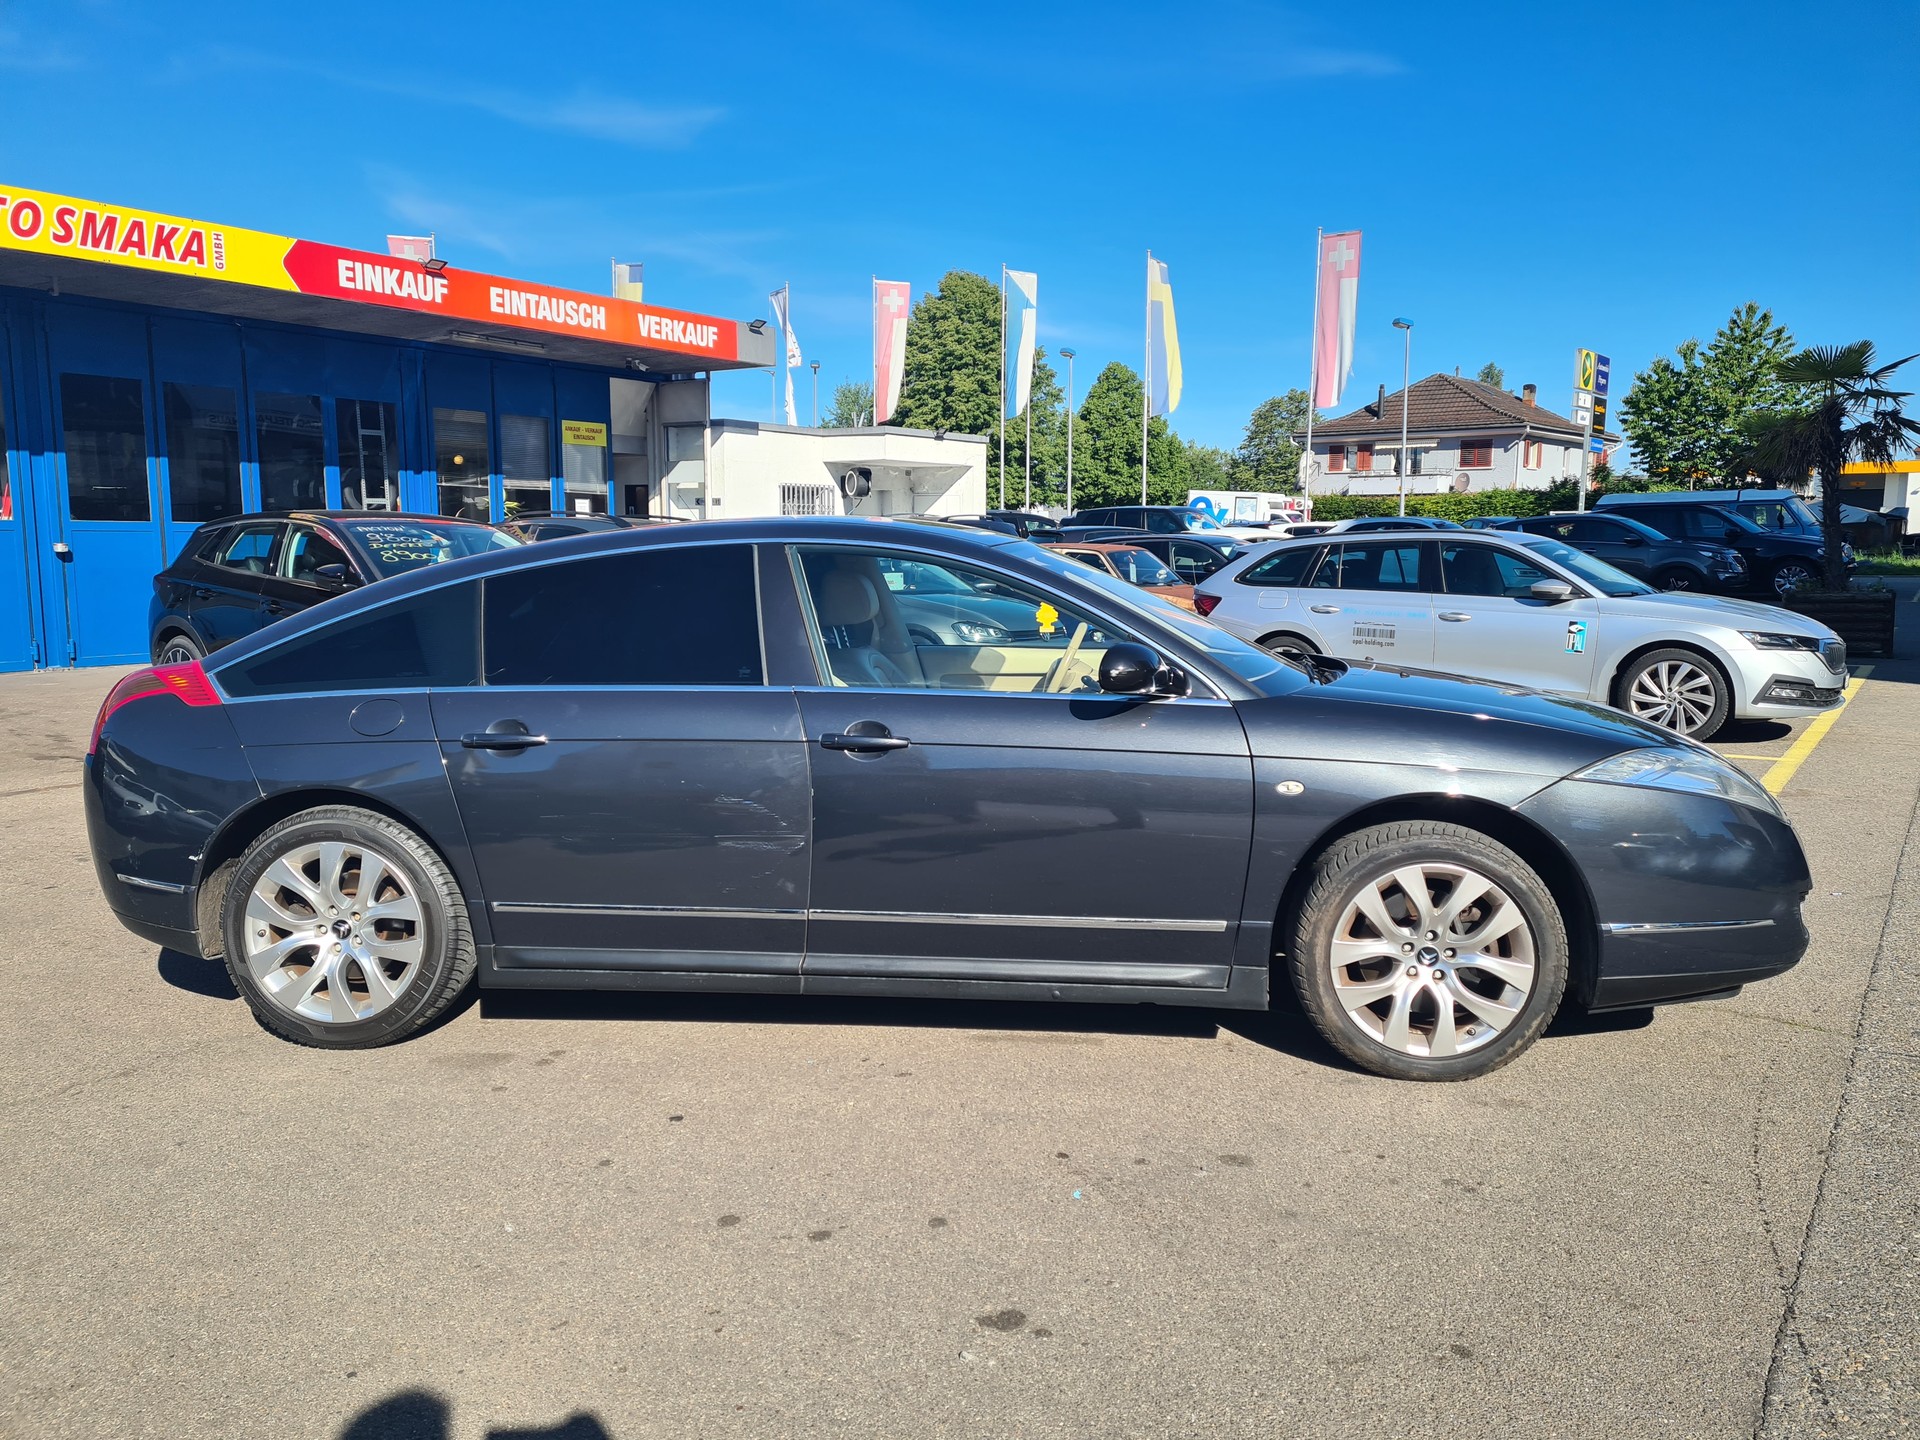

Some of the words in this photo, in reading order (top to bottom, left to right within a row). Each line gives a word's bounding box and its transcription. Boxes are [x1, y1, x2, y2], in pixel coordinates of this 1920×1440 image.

[52, 206, 206, 266] SMAKA
[213, 232, 224, 270] GMBH
[338, 258, 448, 303] EINKAUF
[489, 286, 606, 330] EINTAUSCH
[637, 313, 718, 348] VERKAUF
[380, 549, 438, 563] 8'900
